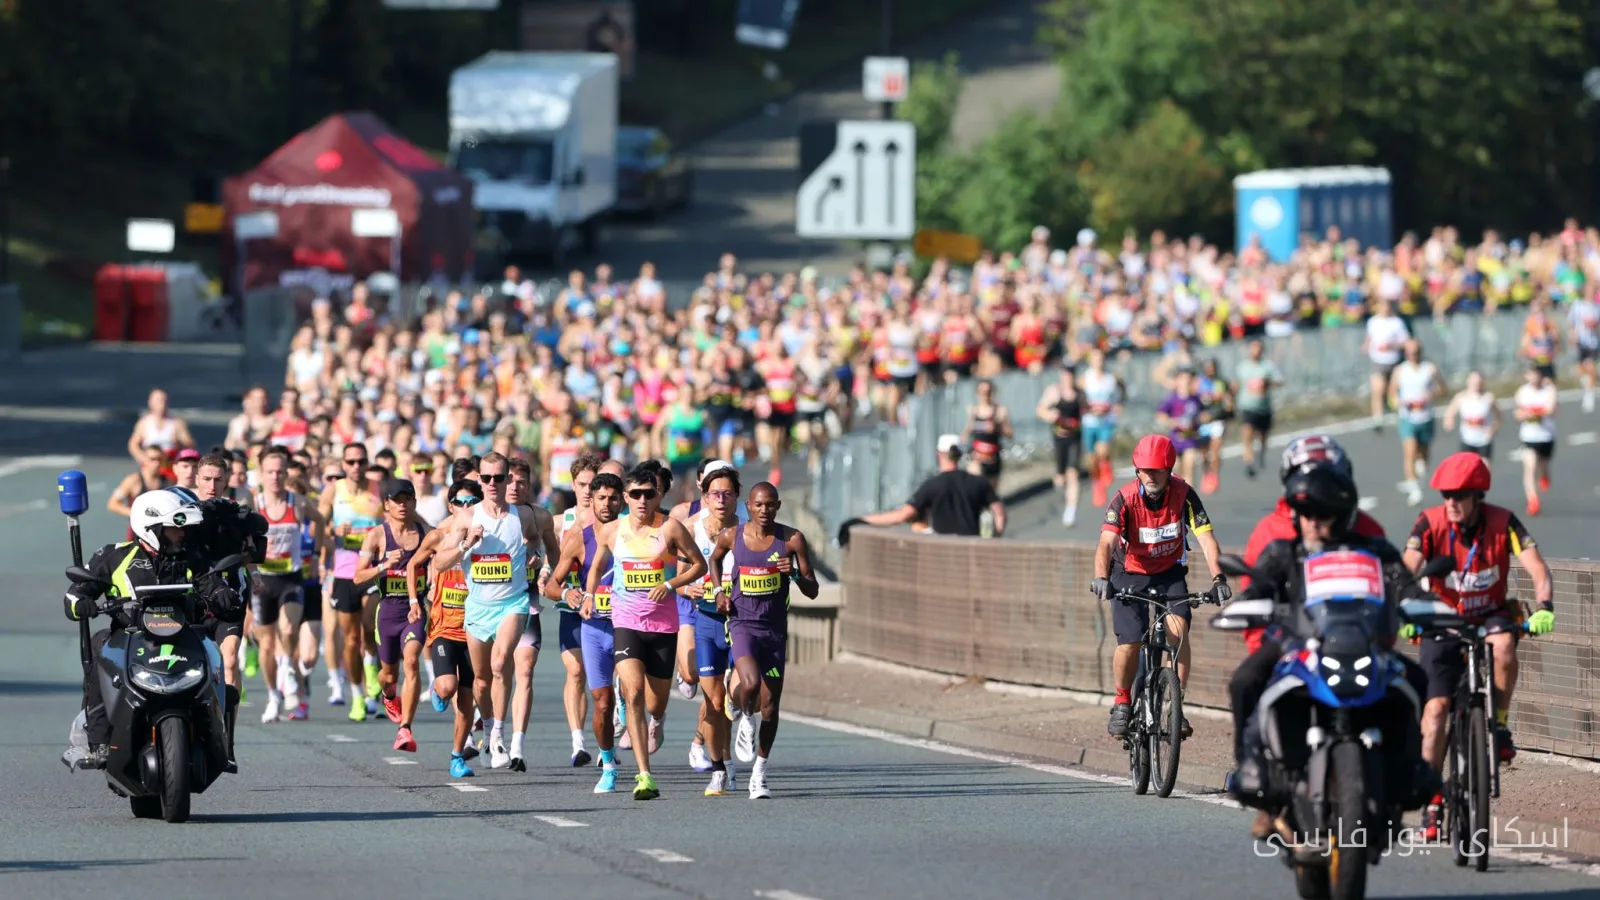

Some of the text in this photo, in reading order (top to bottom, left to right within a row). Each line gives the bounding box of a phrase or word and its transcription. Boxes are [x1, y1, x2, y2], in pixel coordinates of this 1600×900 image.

[474, 565, 508, 576] YOUNG
[627, 573, 662, 583] DEVER
[743, 577, 778, 589] MUTISO
[390, 581, 422, 590] IKEA
[136, 647, 145, 656] 3
